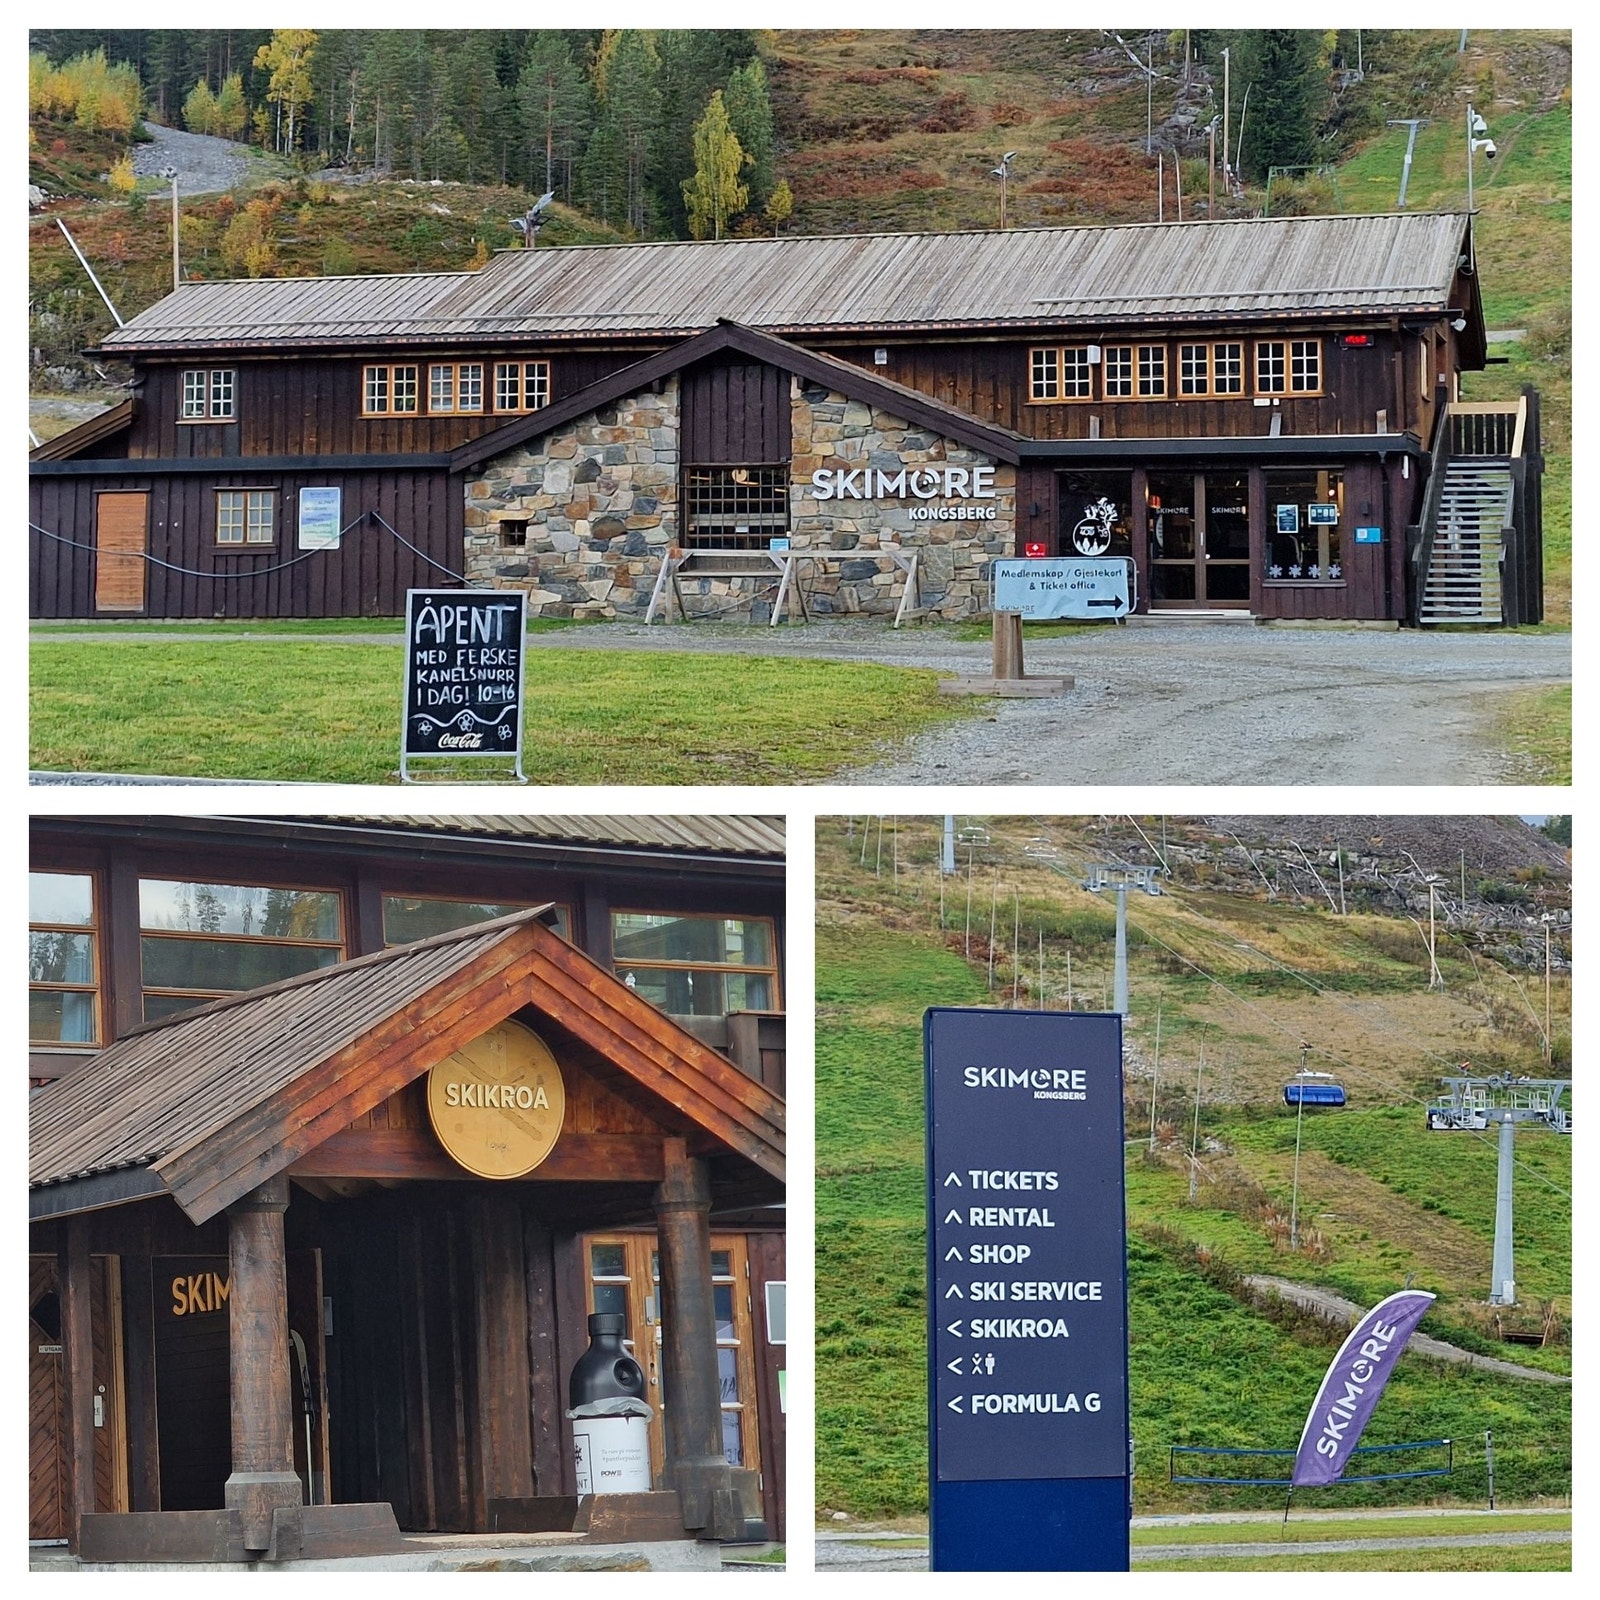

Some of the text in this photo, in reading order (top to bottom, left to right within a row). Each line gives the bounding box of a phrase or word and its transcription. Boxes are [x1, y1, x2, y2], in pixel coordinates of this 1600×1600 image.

[812, 466, 996, 500] SKIMORE
[909, 507, 996, 520] KONGSBERG
[1001, 569, 1064, 580] Medlemskap
[1074, 568, 1123, 579] Gjestekort
[1029, 581, 1096, 590] & Ticket office
[415, 597, 517, 645] ÅPENT
[416, 648, 518, 668] MED FERSKE
[417, 666, 515, 684] KANELSNURR
[417, 682, 515, 706] I DAG! 10-16
[963, 1066, 1087, 1090] SKIMORE
[446, 1083, 549, 1110] SKIKROA
[1033, 1090, 1087, 1101] KONGSBERG
[968, 1170, 1059, 1190] TICKETS
[969, 1207, 1055, 1227] RENTAL
[969, 1244, 1031, 1264] SHOP
[970, 1281, 1102, 1301] SKI SERVICE
[970, 1318, 1069, 1338] SKIKROA
[1316, 1320, 1397, 1458] SKIMORE
[971, 1392, 1101, 1414] FORMULA G
[577, 1478, 588, 1489] NT
